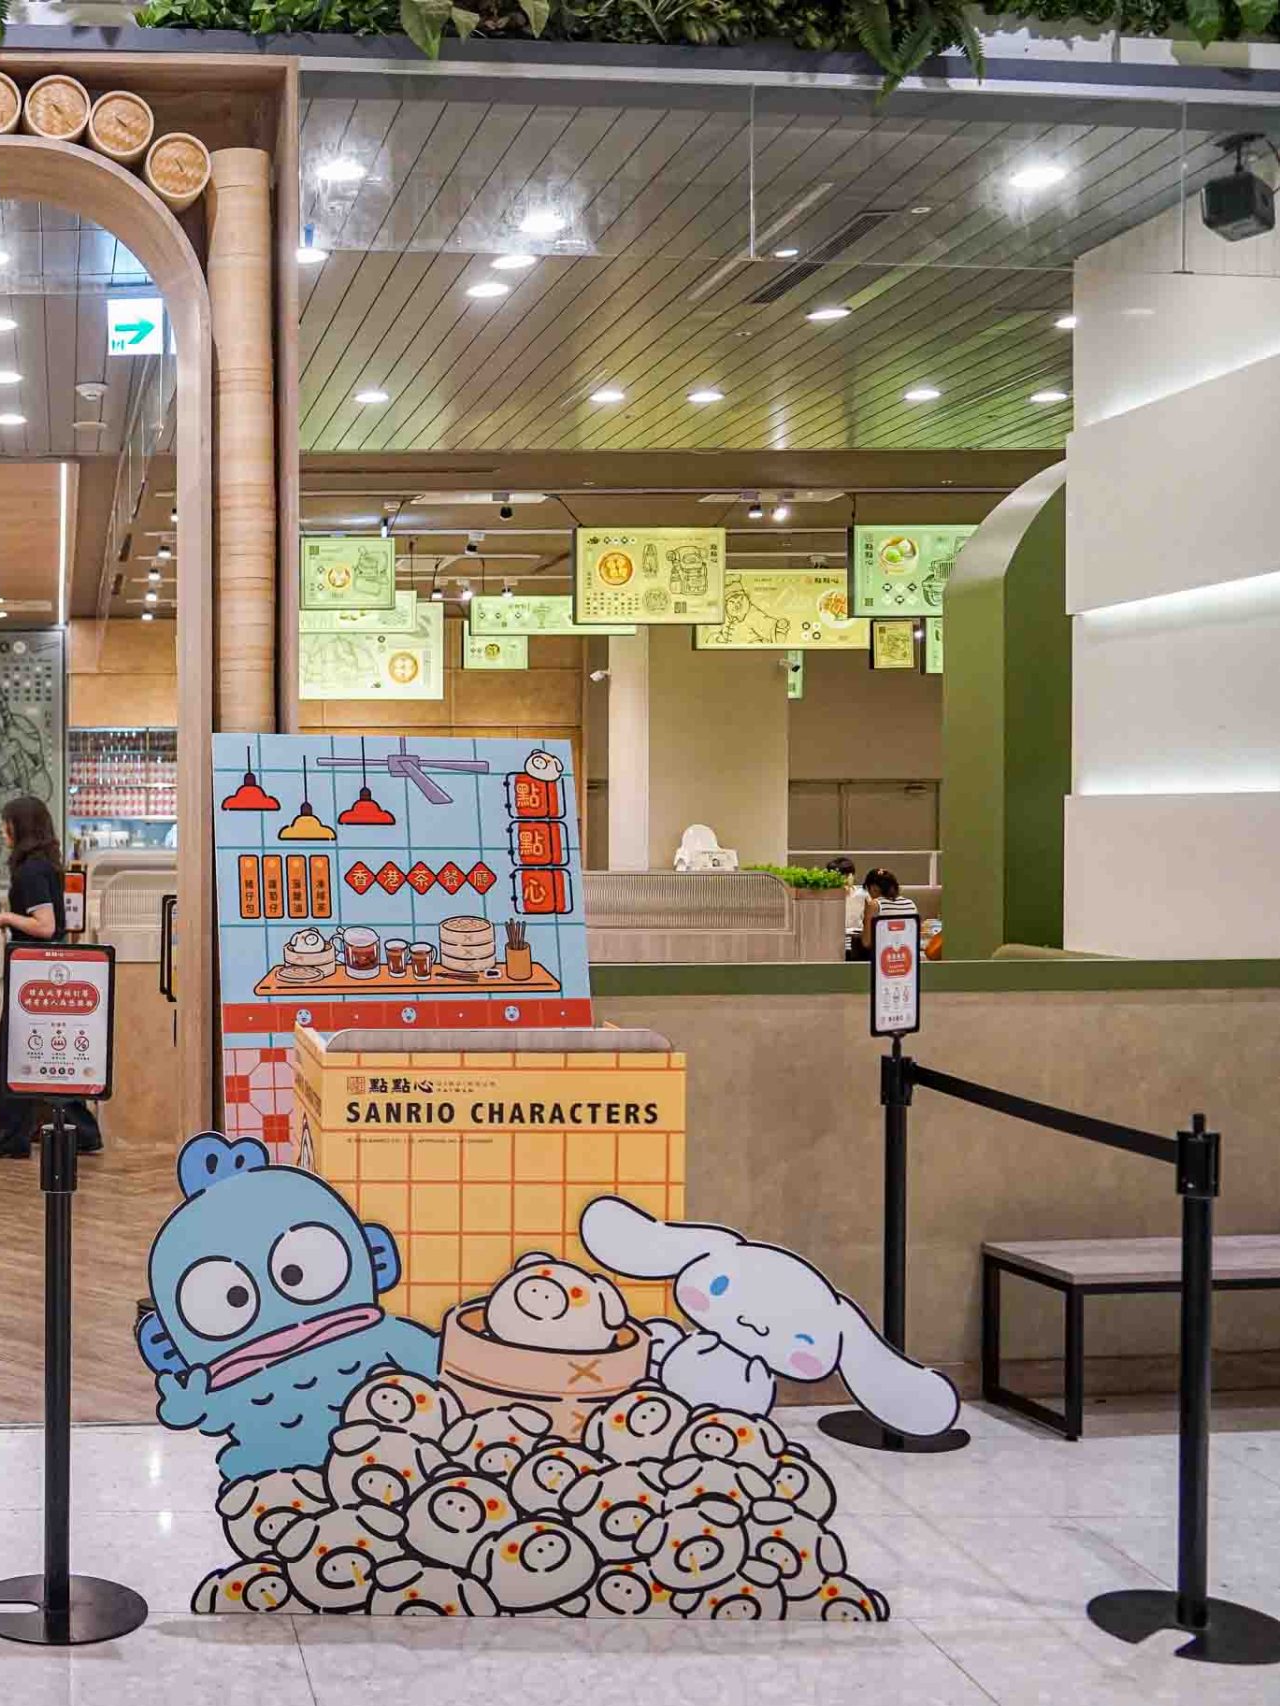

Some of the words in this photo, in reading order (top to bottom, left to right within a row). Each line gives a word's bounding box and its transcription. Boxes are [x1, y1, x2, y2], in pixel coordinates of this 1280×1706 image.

[516, 782, 546, 904] 點點心
[352, 869, 489, 887] 香港茶餐廳
[368, 1077, 434, 1094] 點點心
[346, 1101, 455, 1124] SANRIO
[470, 1101, 660, 1125] CHARACTERS
